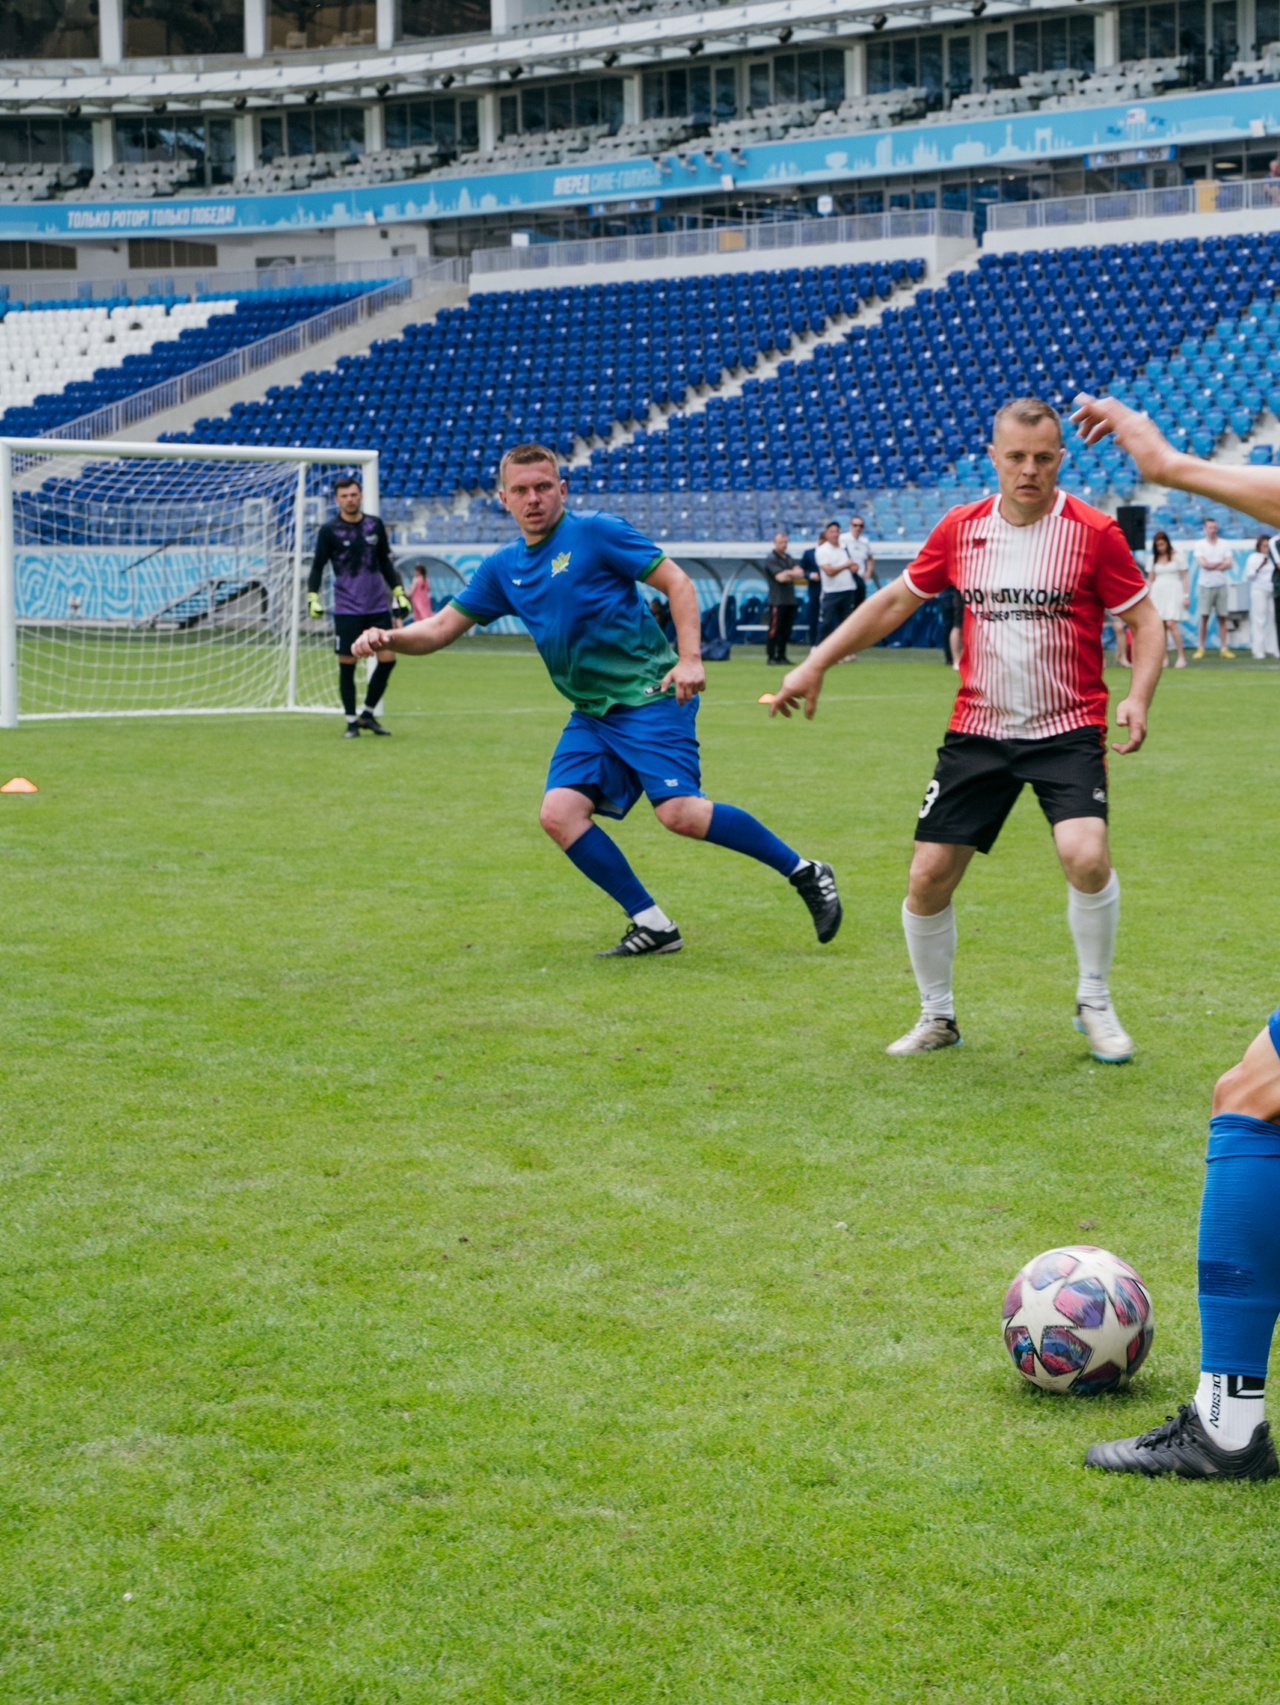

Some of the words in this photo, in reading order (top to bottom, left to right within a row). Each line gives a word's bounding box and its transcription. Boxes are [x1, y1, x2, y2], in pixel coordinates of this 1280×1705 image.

[67, 210, 111, 229] ТОЛЬКО
[111, 209, 150, 228] РОТОР!
[151, 208, 191, 226] ТОЛЬКО
[191, 205, 236, 225] ПОБЕДА!
